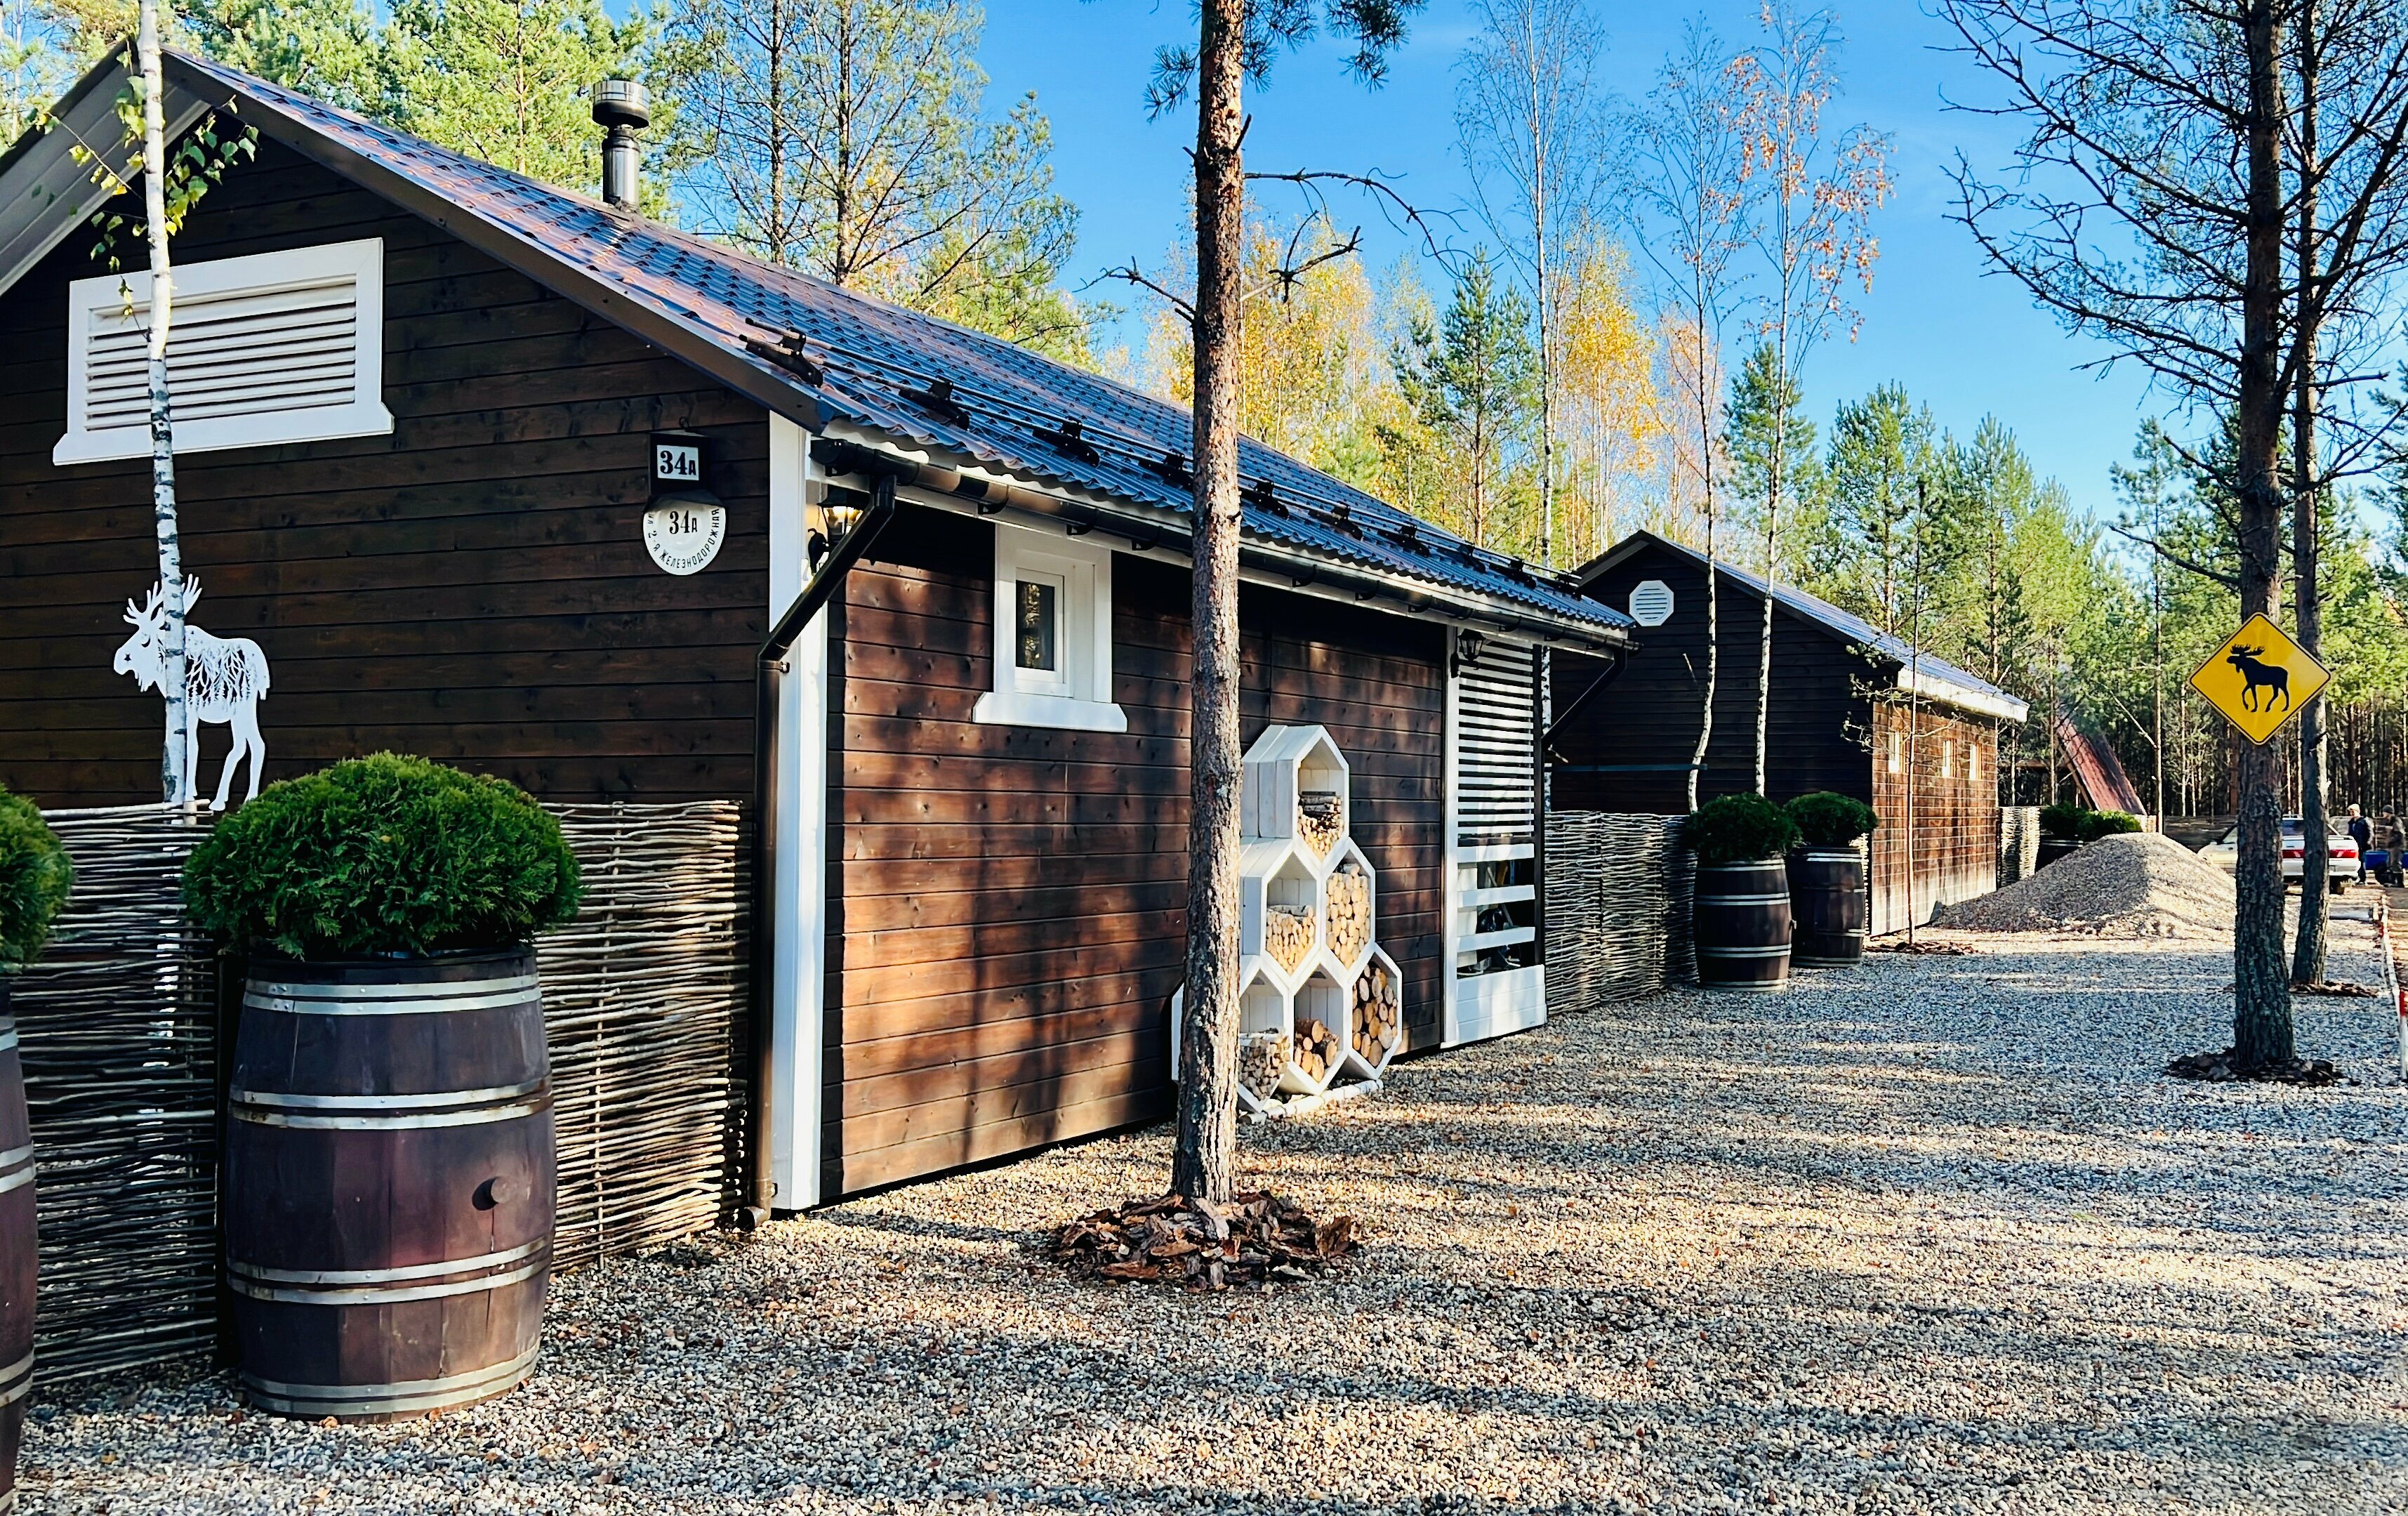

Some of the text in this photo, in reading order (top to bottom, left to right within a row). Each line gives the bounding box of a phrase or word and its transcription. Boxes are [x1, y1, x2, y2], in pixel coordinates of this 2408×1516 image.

[660, 450, 697, 476] 34А
[669, 510, 698, 534] 34А
[659, 508, 720, 569] ЖЕЛЕЗНОДОРОЖНАЯ
